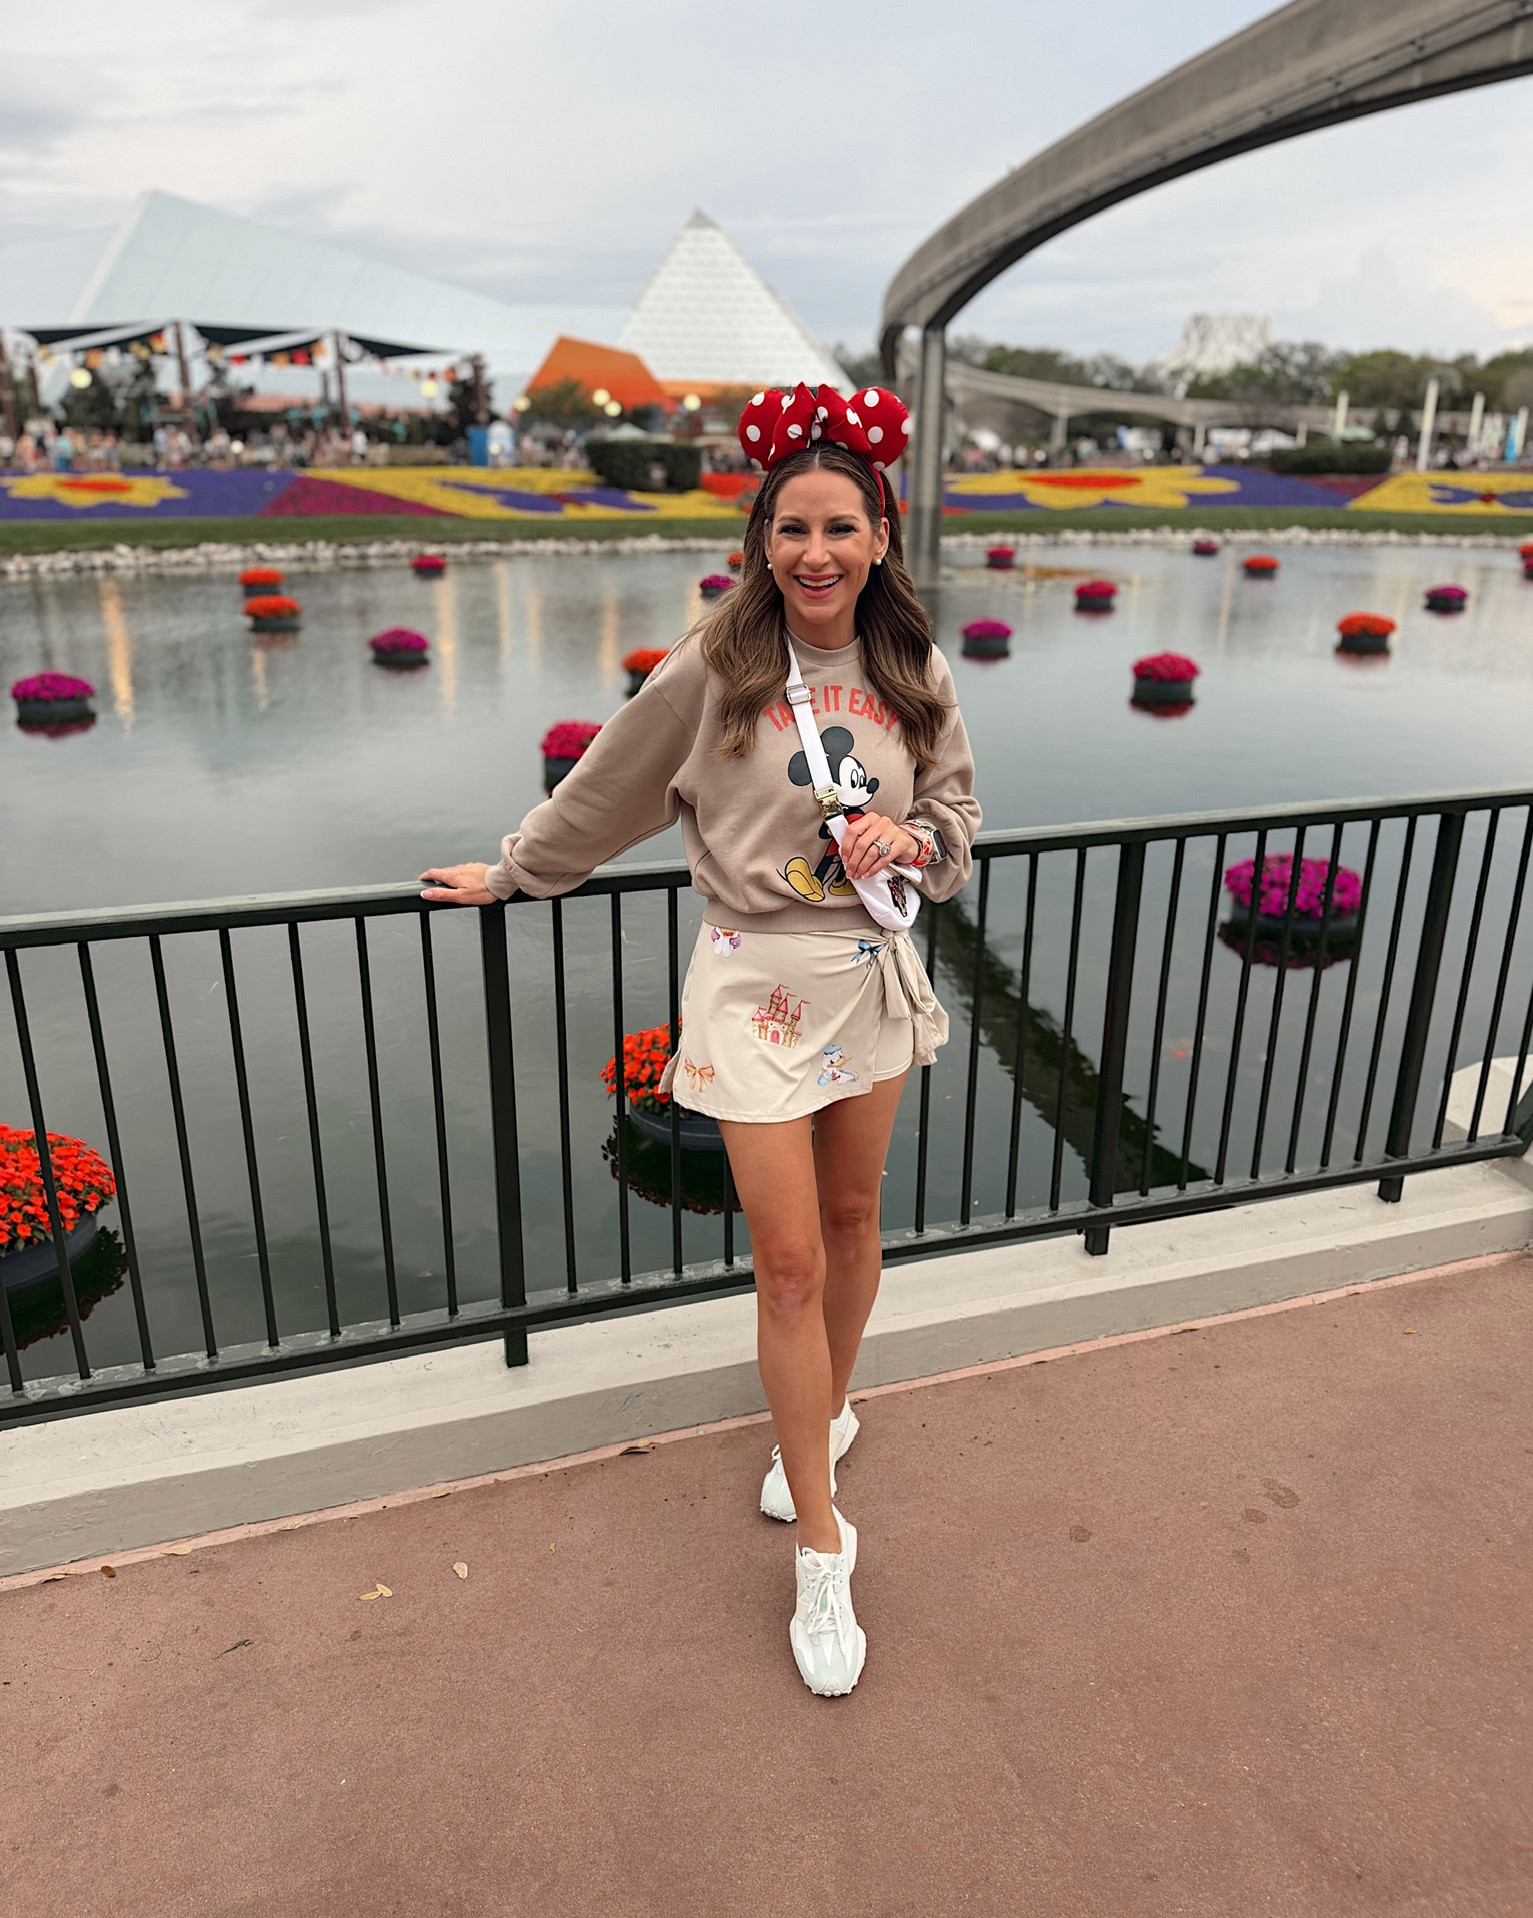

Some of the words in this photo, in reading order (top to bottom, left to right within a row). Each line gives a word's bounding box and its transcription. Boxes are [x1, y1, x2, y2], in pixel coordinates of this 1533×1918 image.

[763, 687, 820, 732] TAE
[824, 685, 843, 712] IT
[849, 688, 901, 731] EASY
